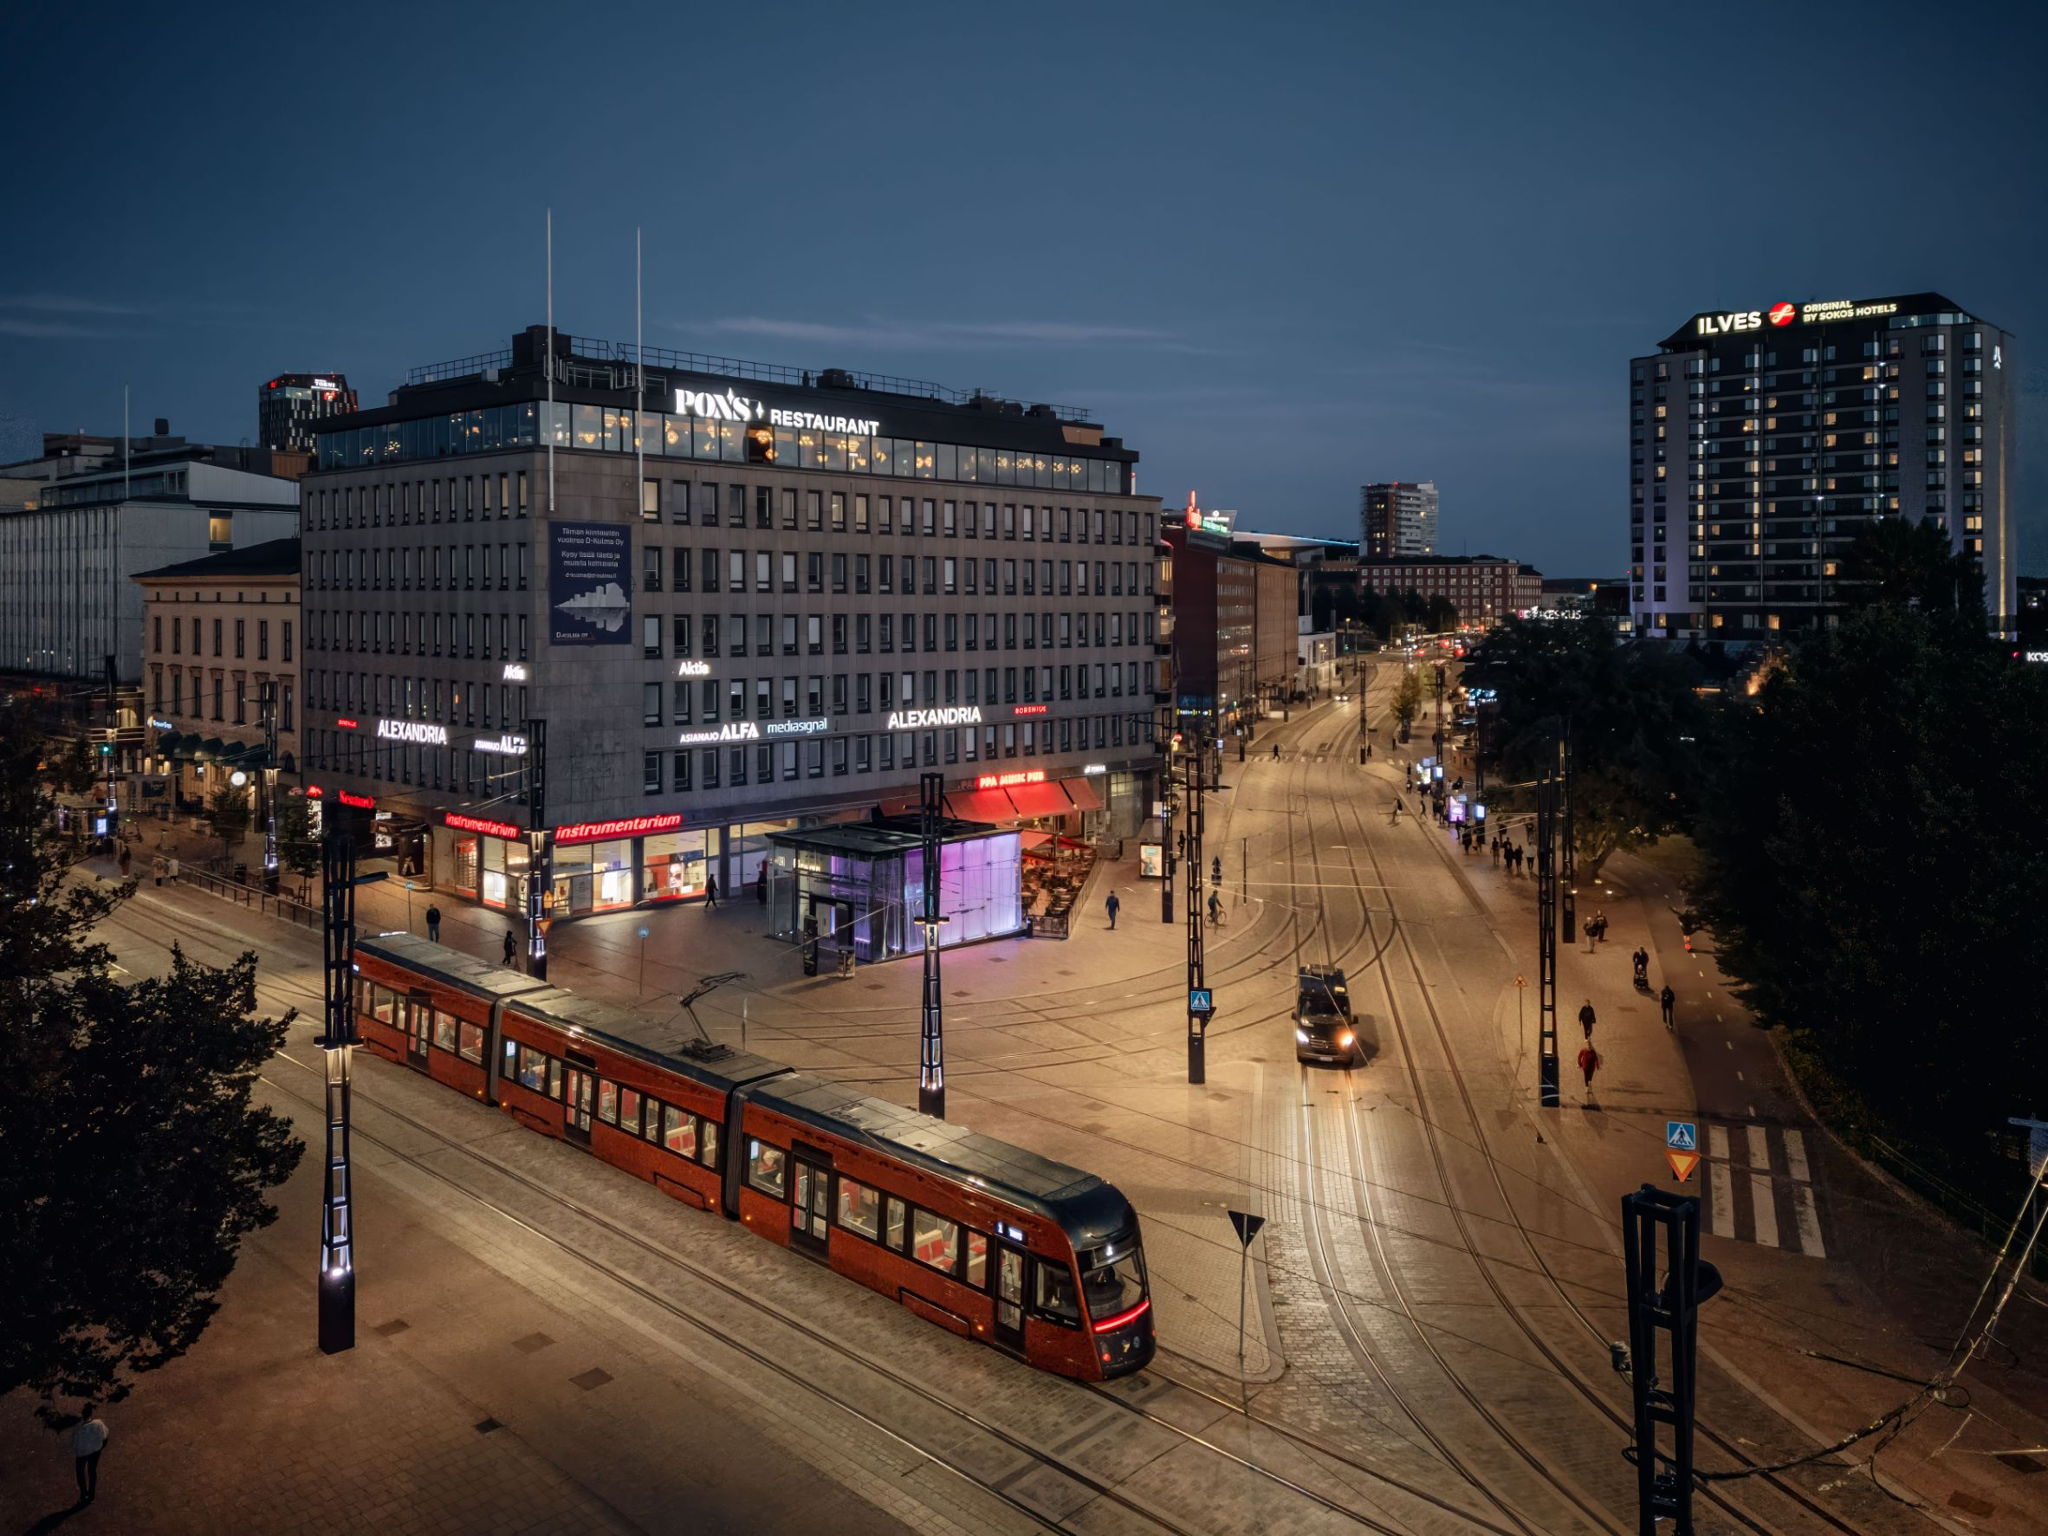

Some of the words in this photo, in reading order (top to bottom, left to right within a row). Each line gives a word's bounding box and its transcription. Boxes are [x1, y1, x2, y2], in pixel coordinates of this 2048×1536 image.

[1803, 301, 1853, 313] ORIGINAL
[1803, 314, 1817, 322] BY
[1819, 310, 1854, 321] SOKOS
[1856, 304, 1897, 316] HOTELS
[1698, 311, 1762, 335] ILVES
[770, 409, 880, 436] RESTAURANT
[679, 661, 710, 675] Aktia
[767, 718, 828, 734] mediasignal
[888, 707, 982, 729] ALEXANDRIA
[377, 720, 448, 745] ALEXANDRIA
[680, 732, 720, 743] ASIANAJO
[720, 722, 760, 741] ALFA
[445, 812, 518, 837] instrumentarium
[555, 813, 682, 840] instrumentarium
